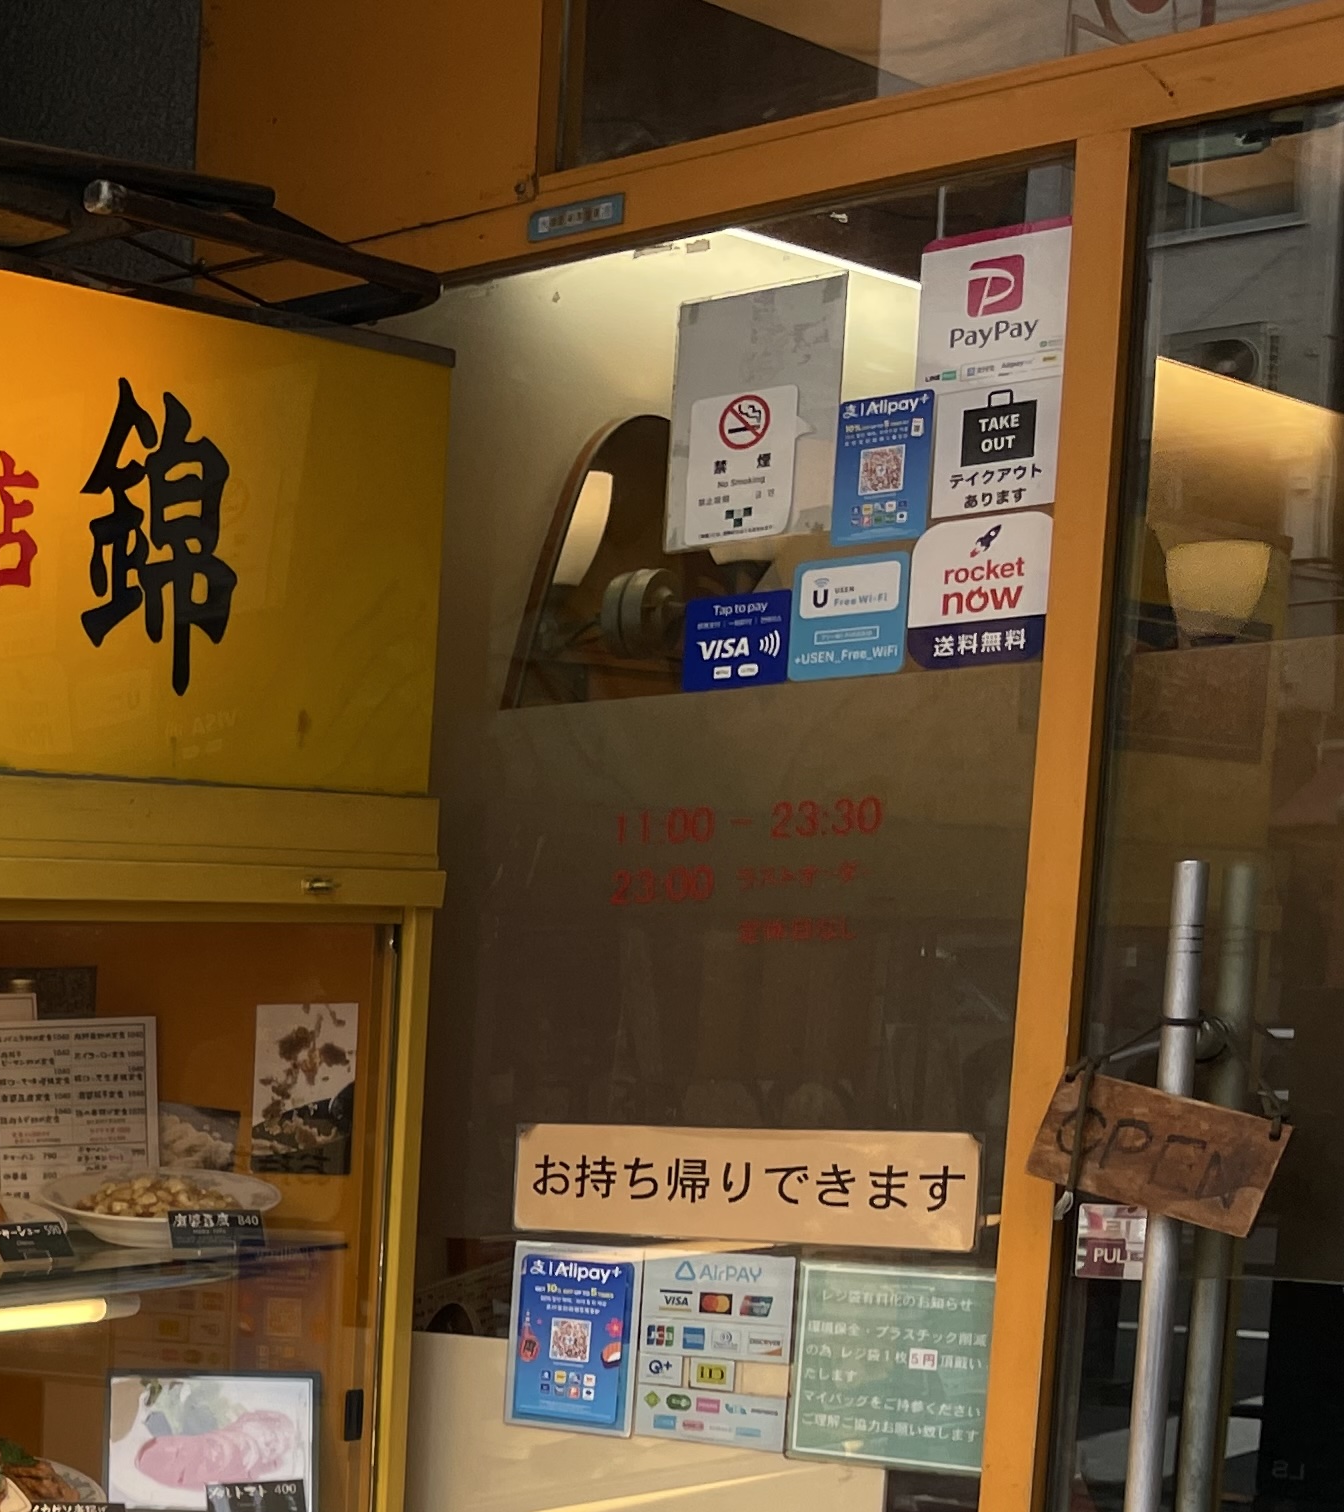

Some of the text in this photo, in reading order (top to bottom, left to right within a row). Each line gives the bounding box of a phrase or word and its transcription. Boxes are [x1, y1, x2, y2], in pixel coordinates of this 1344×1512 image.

[949, 319, 1040, 349] PayPay
[978, 413, 1020, 433] TAKE
[981, 434, 1016, 452] OUT
[730, 476, 766, 488] Smoking
[949, 463, 1042, 489] テイクアウト
[964, 487, 1027, 509] あります
[80, 376, 237, 696] 錦
[943, 556, 1025, 585] rocket
[713, 601, 768, 617] Tap to pay
[834, 597, 857, 607] Free
[941, 585, 1024, 616] now
[697, 637, 750, 660] VISA
[933, 628, 1026, 657] 送料無料
[770, 796, 884, 840] 23:30
[530, 1151, 967, 1213] お持ち帰りできます
[699, 1264, 762, 1282] AirPAY
[664, 1295, 689, 1306] VISA
[804, 1367, 858, 1382] たします
[274, 1483, 297, 1495] 400
